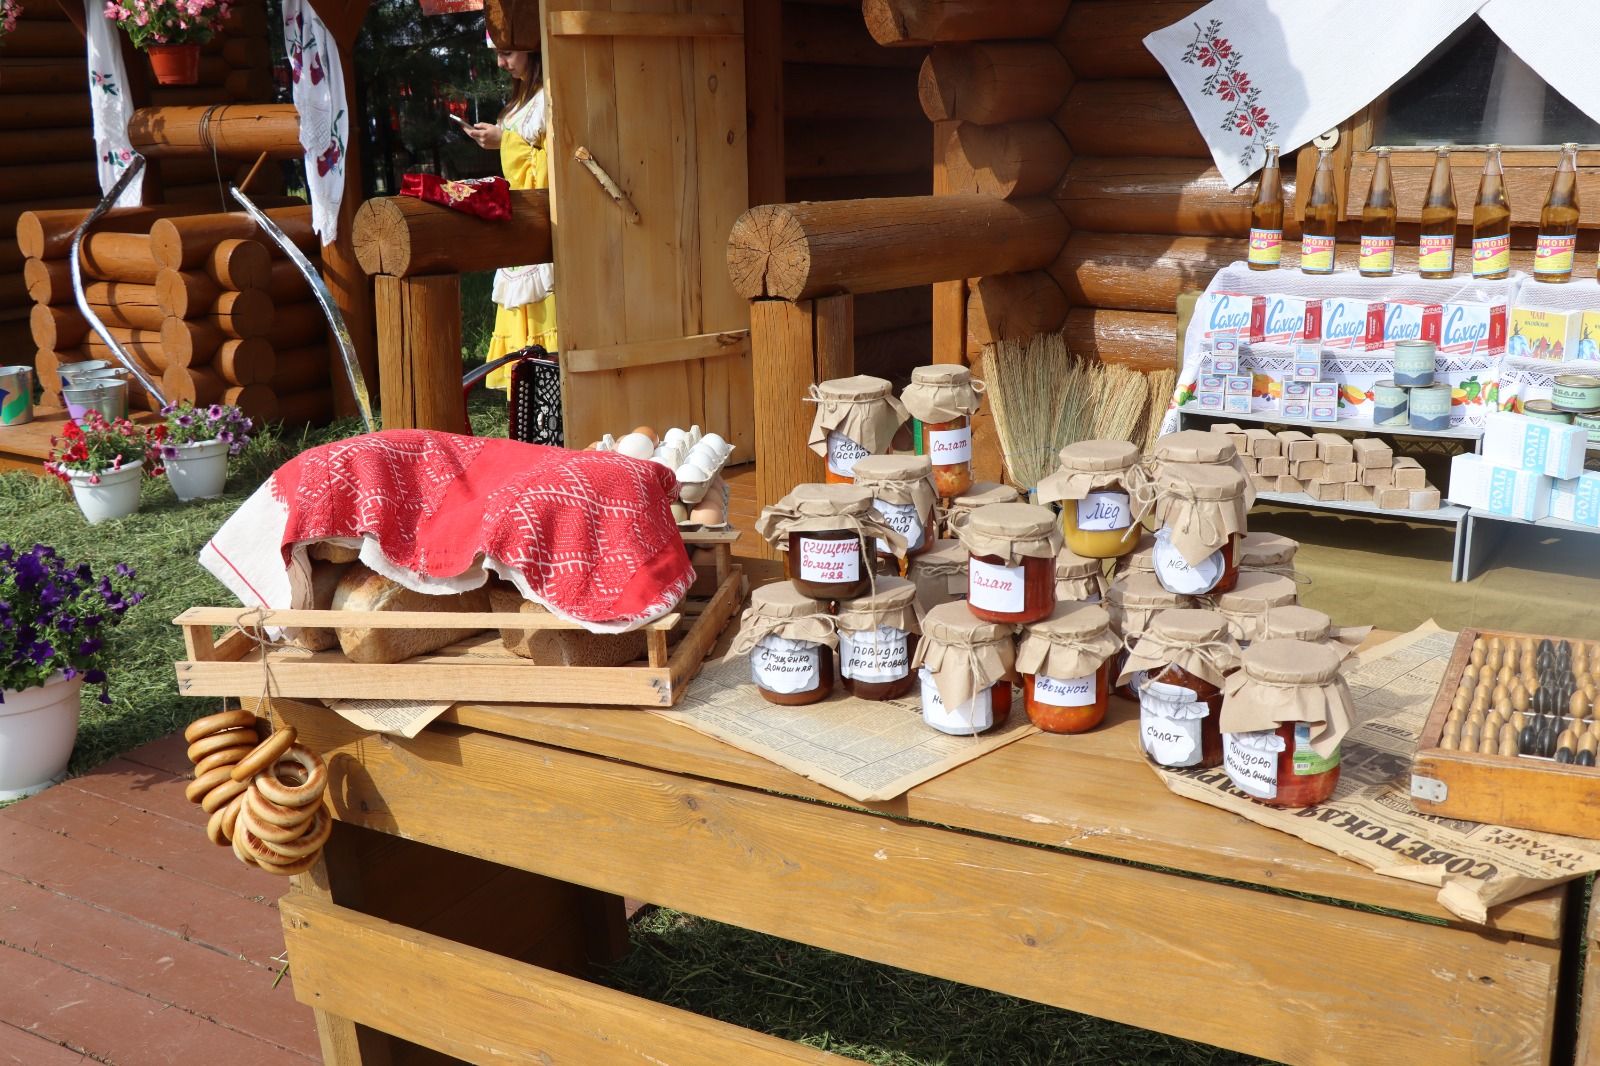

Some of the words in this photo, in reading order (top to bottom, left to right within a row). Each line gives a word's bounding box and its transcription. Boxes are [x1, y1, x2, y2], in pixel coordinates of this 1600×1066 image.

[1210, 295, 1249, 333] Сахар
[1266, 299, 1303, 345] Сахар
[1326, 302, 1364, 348] Сахар
[1385, 304, 1420, 340] Сахар
[1444, 306, 1487, 354] Сахар
[933, 440, 967, 452] Салат
